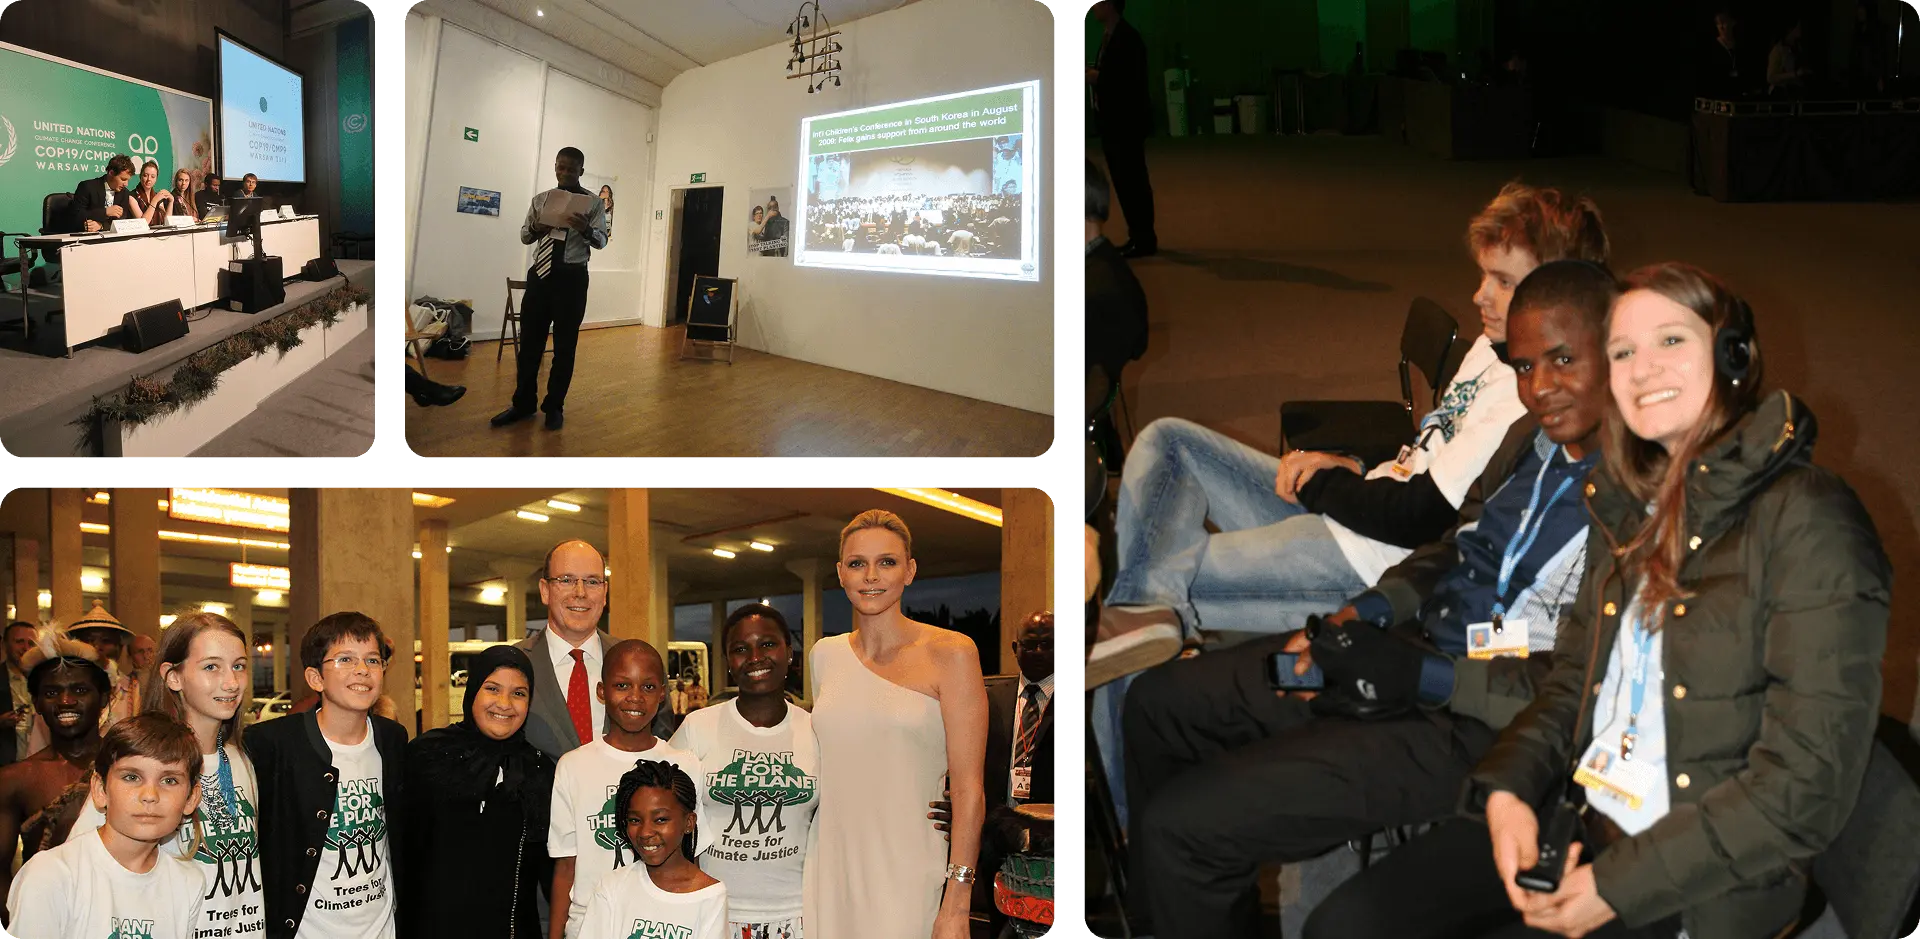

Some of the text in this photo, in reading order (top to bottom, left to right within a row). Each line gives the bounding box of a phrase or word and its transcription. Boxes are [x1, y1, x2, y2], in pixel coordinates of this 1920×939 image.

[248, 121, 266, 131] UNITED
[825, 126, 858, 137] Children's
[859, 119, 902, 132] Conference
[904, 118, 912, 126] in
[915, 113, 939, 124] South
[941, 111, 968, 121] Korea
[971, 109, 980, 117] in
[982, 103, 1018, 116] August
[33, 120, 116, 140] UNITED NATIONS
[856, 132, 875, 143] gains
[877, 129, 906, 140] support
[908, 126, 927, 136] from
[929, 122, 959, 133] around
[962, 120, 976, 129] the
[979, 116, 1006, 127] world
[34, 134, 116, 149] CLIMATE CHANGE CONFERENCE
[35, 145, 116, 162] COP19/CMP9
[36, 161, 107, 173] WARSAW 20
[732, 749, 793, 764] PLANT
[741, 763, 785, 776] FOR
[337, 777, 378, 797] LANT
[706, 773, 817, 790] THE PLANET
[338, 794, 372, 812] FOR
[344, 805, 384, 826] PLAN
[586, 813, 617, 831] THE
[722, 834, 783, 848] Trees for
[706, 844, 799, 861] limate Justice
[334, 878, 382, 897] Trees for
[206, 904, 259, 922] Trees for
[314, 898, 362, 911] Climate
[111, 916, 154, 935] PANT
[192, 918, 264, 939] imate Justi
[631, 919, 692, 939] PLANT
